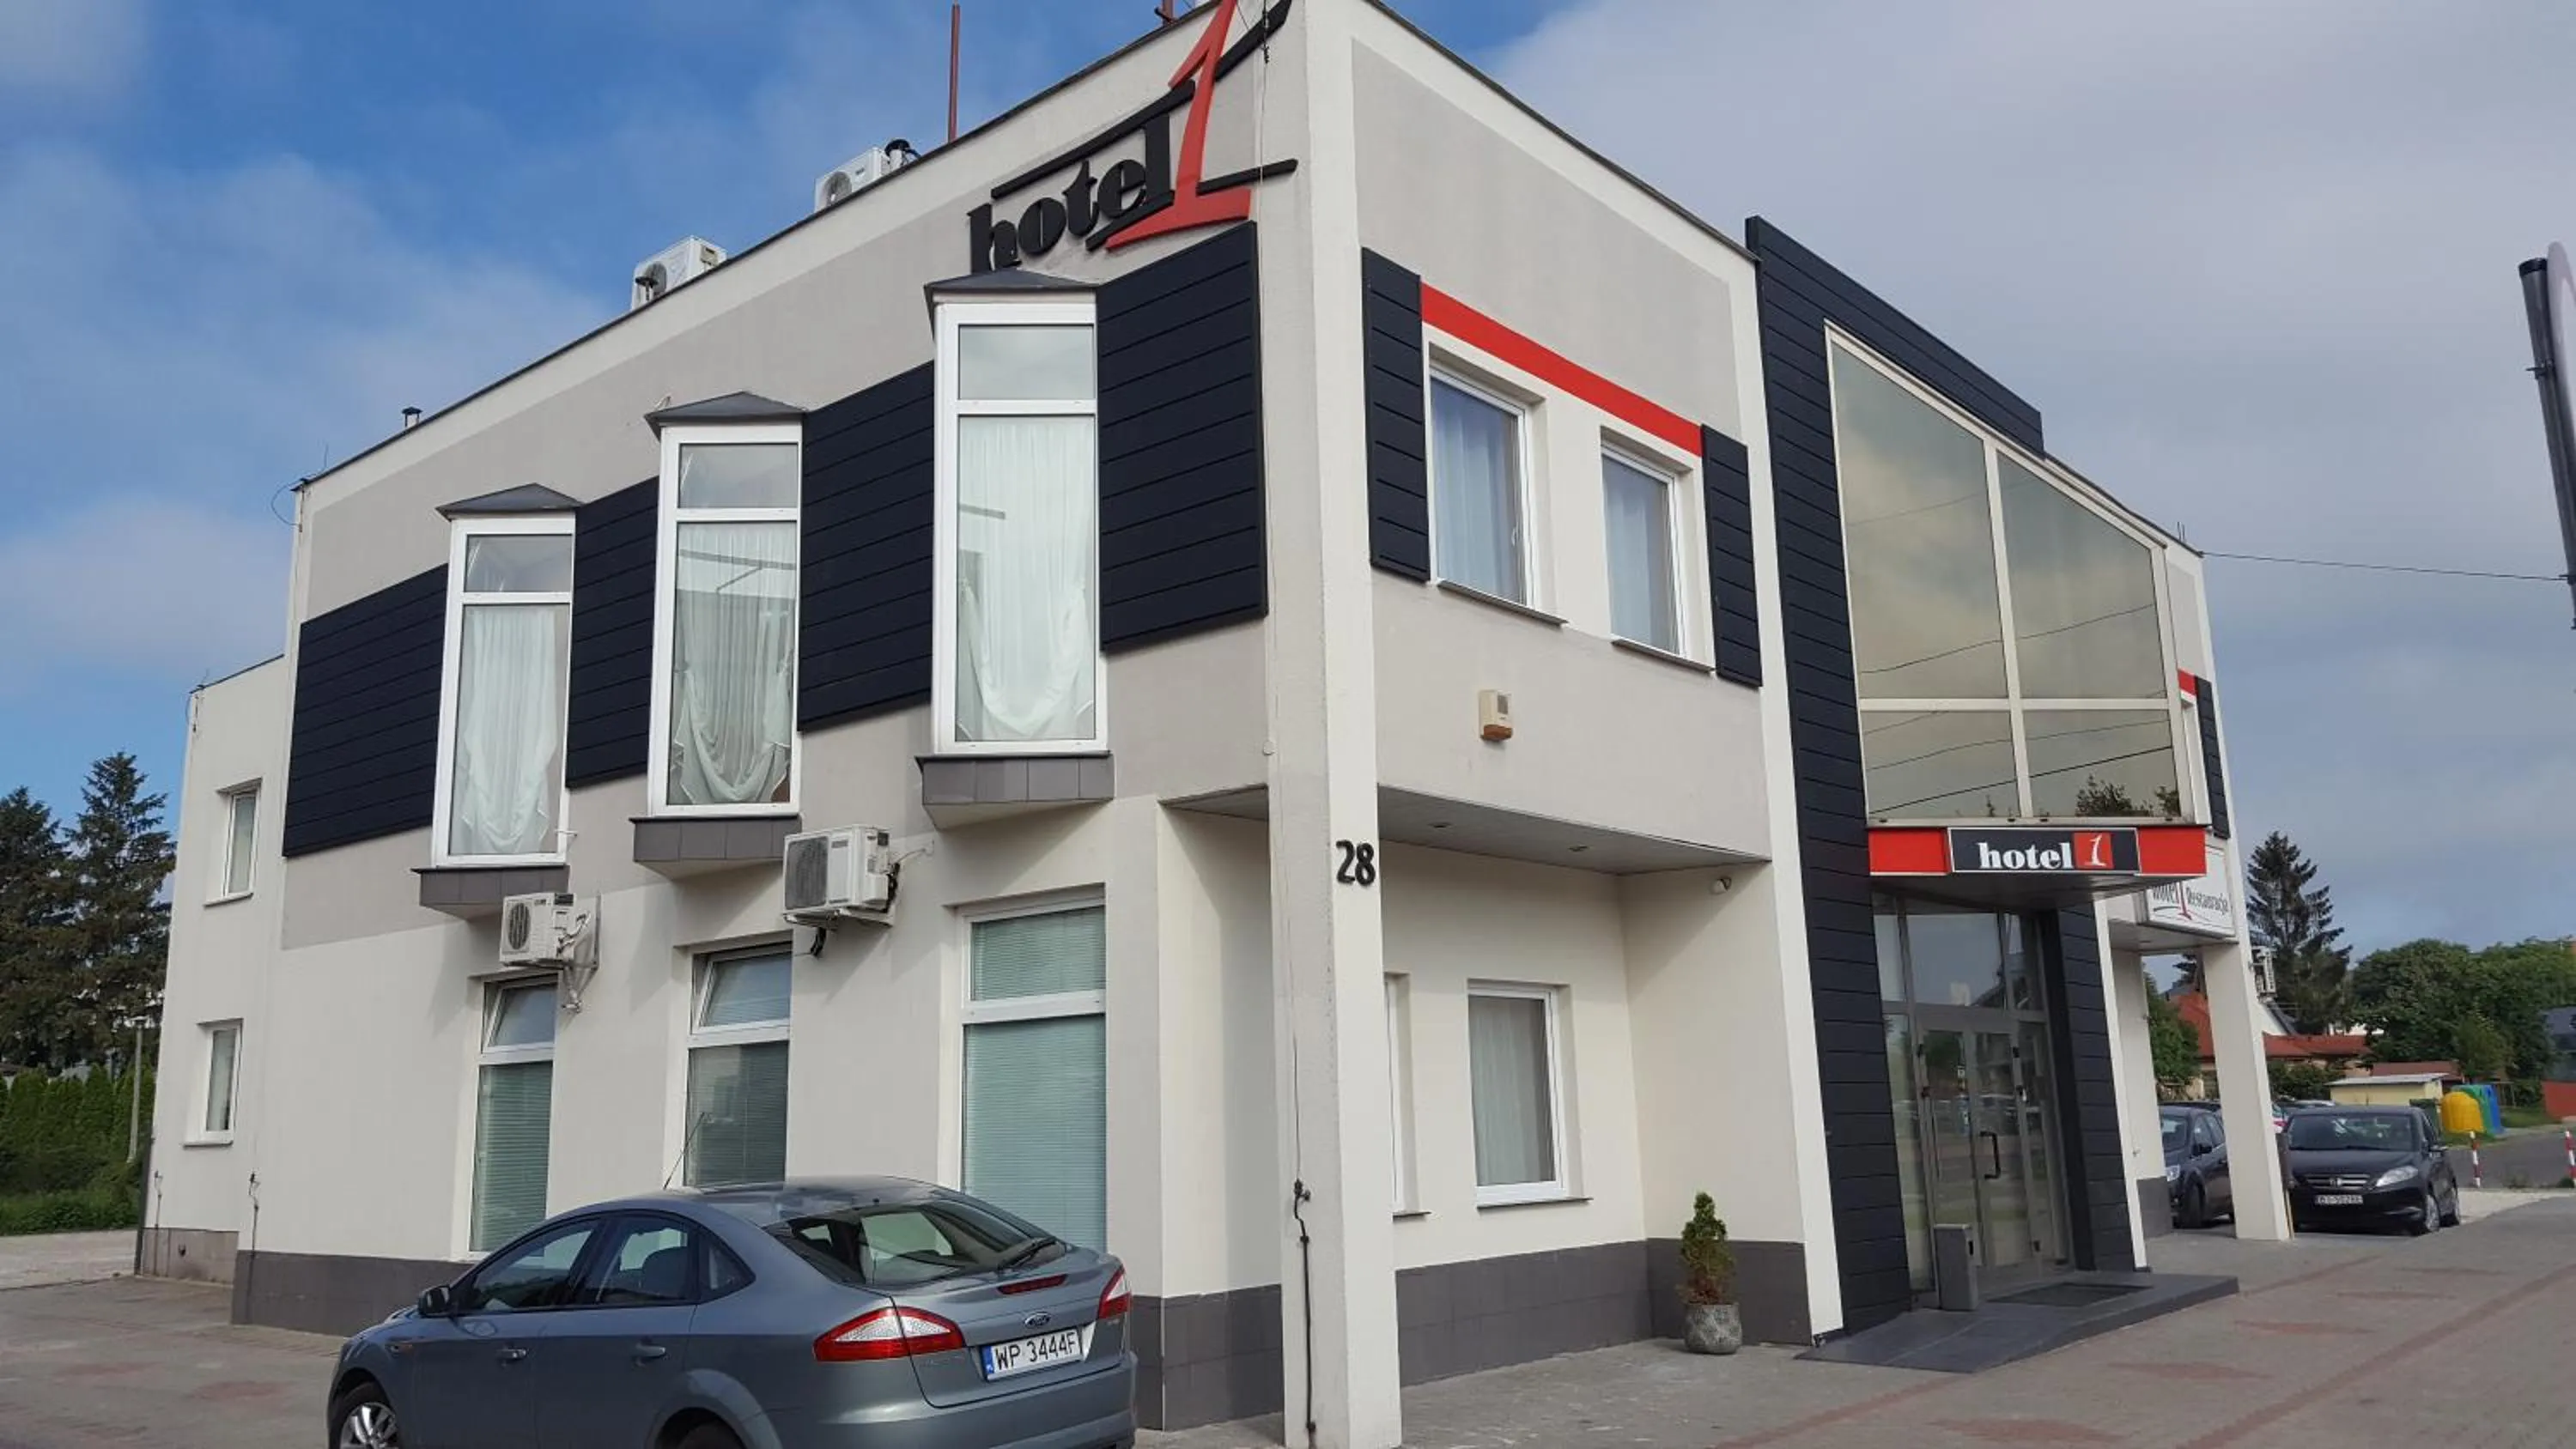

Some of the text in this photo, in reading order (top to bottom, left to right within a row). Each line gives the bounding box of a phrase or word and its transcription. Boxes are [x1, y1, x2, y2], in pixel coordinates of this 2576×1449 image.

[967, 0, 1251, 274] hotel 1
[1336, 840, 1376, 886] 28
[1977, 834, 2106, 869] hotel 1
[995, 1344, 1021, 1370] WP
[1027, 1331, 1076, 1362] 3444F
